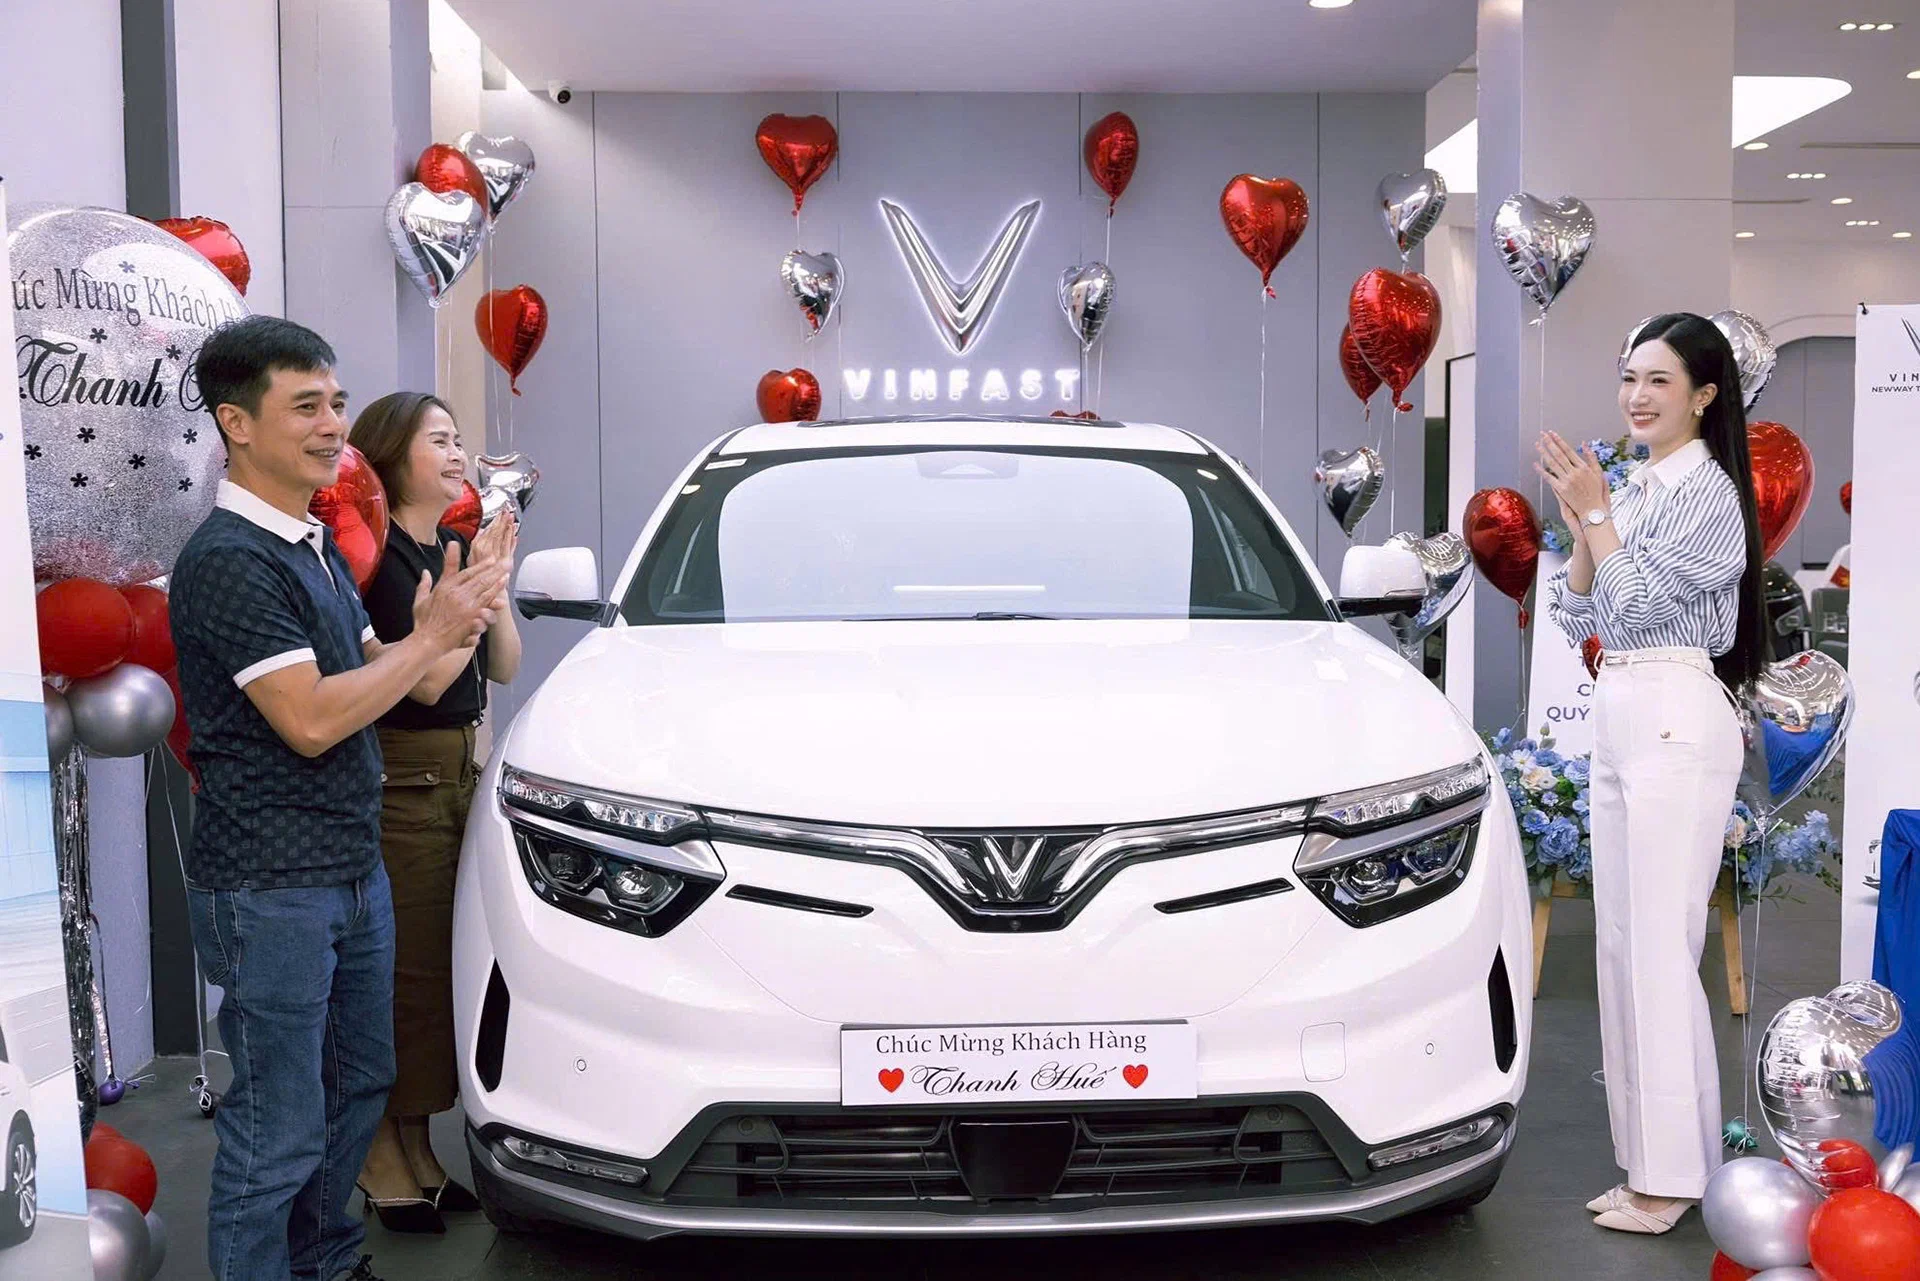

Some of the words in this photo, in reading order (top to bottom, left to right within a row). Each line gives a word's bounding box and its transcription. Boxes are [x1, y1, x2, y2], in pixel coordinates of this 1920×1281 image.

[12, 270, 45, 311] úc
[54, 267, 141, 326] Mừng
[143, 275, 218, 331] Khách
[16, 335, 169, 407] Thanh
[842, 367, 1081, 400] VINFAST
[1889, 372, 1920, 382] VIN
[1871, 385, 1913, 393] NEWWAY
[1546, 704, 1591, 722] QUÝ
[876, 1031, 931, 1054] Chúc
[939, 1031, 1004, 1056] Mừng
[1011, 1030, 1082, 1052] Khách
[1089, 1029, 1147, 1053] Hàng
[910, 1064, 1020, 1096] Thanh
[1030, 1061, 1117, 1091] Huế
